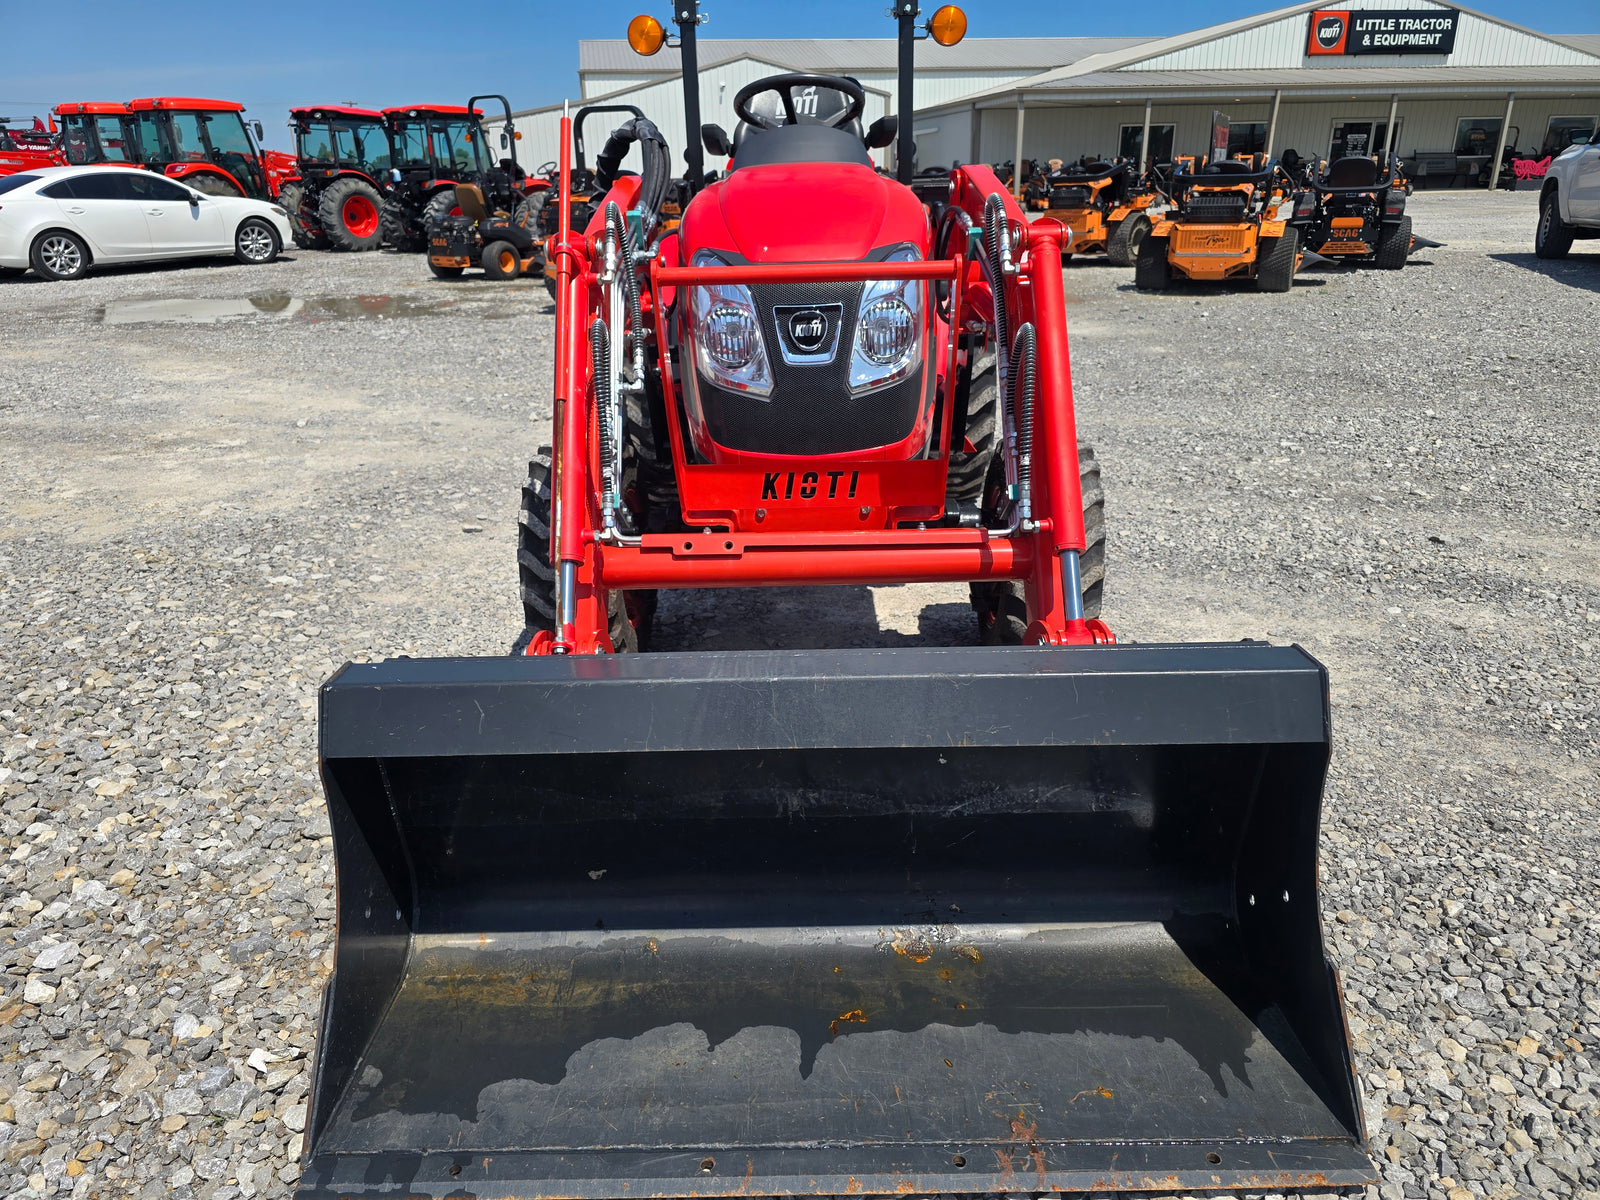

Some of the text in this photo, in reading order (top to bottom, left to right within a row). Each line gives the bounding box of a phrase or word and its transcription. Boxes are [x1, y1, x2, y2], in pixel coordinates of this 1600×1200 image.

[1355, 18, 1452, 31] LITTLE TRACTOR
[1319, 27, 1340, 38] KIOTI
[1362, 33, 1442, 46] & EQUIPMENT
[1332, 228, 1359, 238] SCAG
[794, 323, 822, 337] KIOTI
[761, 470, 860, 500] KIOTI
